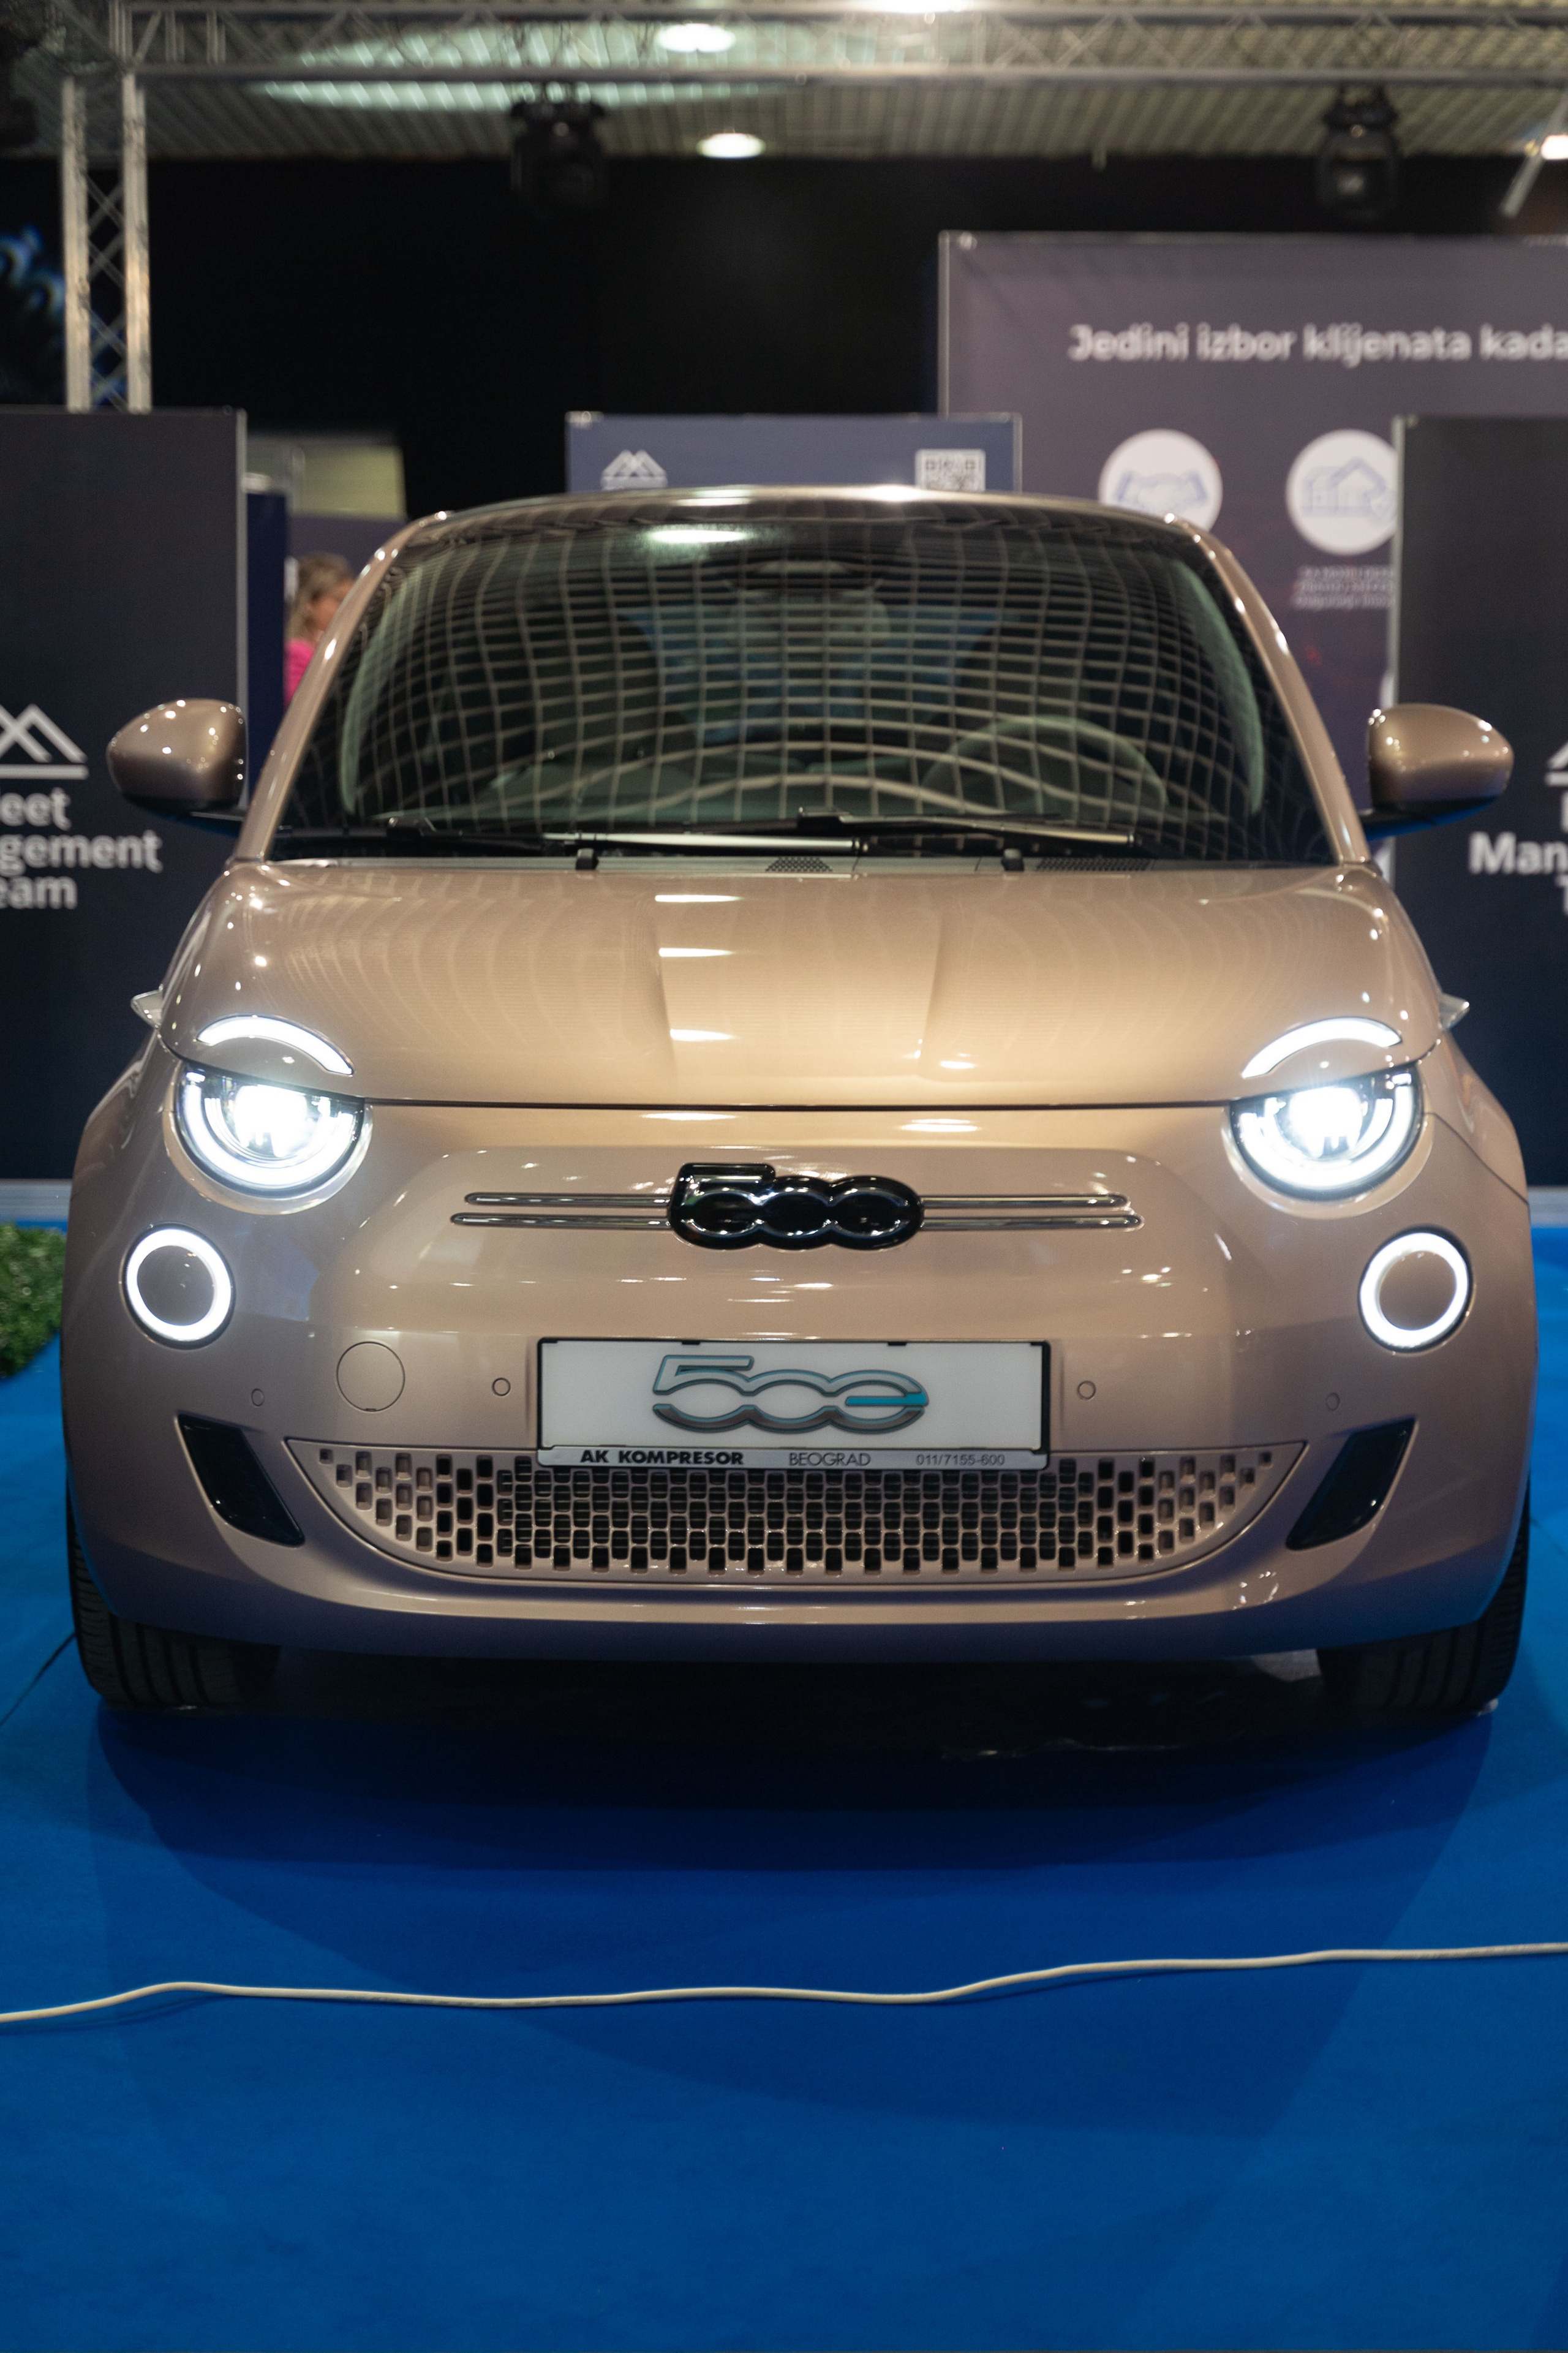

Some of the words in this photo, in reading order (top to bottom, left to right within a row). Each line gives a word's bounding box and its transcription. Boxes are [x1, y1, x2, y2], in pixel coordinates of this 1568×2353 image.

[1069, 323, 1189, 361] Jedini
[1196, 322, 1297, 361] izbor
[1303, 323, 1471, 368] klijenata
[1479, 323, 1568, 360] kada
[669, 1163, 924, 1250] 500
[580, 1450, 609, 1464] AK
[619, 1450, 744, 1465] KOMPRESOR
[788, 1452, 871, 1467] BEOGRAD
[916, 1454, 1006, 1465] 011/7155-600
